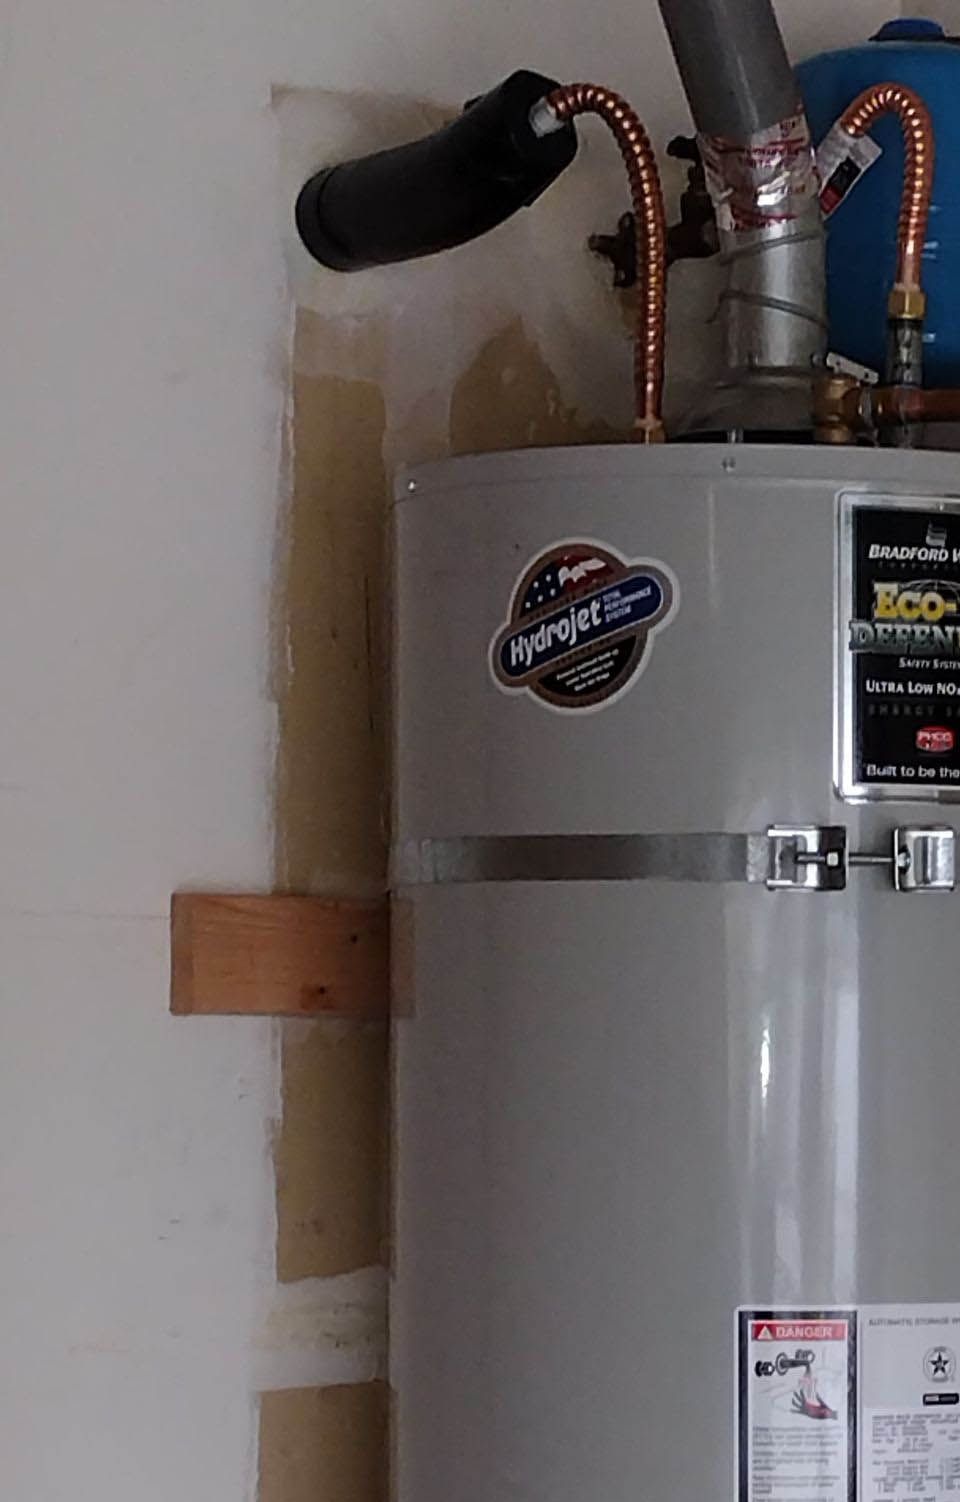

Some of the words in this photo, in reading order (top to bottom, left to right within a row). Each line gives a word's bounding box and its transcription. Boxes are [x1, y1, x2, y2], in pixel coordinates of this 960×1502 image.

[868, 543, 949, 562] BRADFORD
[510, 598, 602, 668] Hydrojet
[899, 656, 930, 669] SAFETY
[866, 679, 904, 694] ULTRA
[908, 680, 934, 695] LOW
[900, 765, 915, 778] to
[918, 765, 936, 779] be
[939, 766, 960, 779] the
[775, 1326, 833, 1338] DANGER
